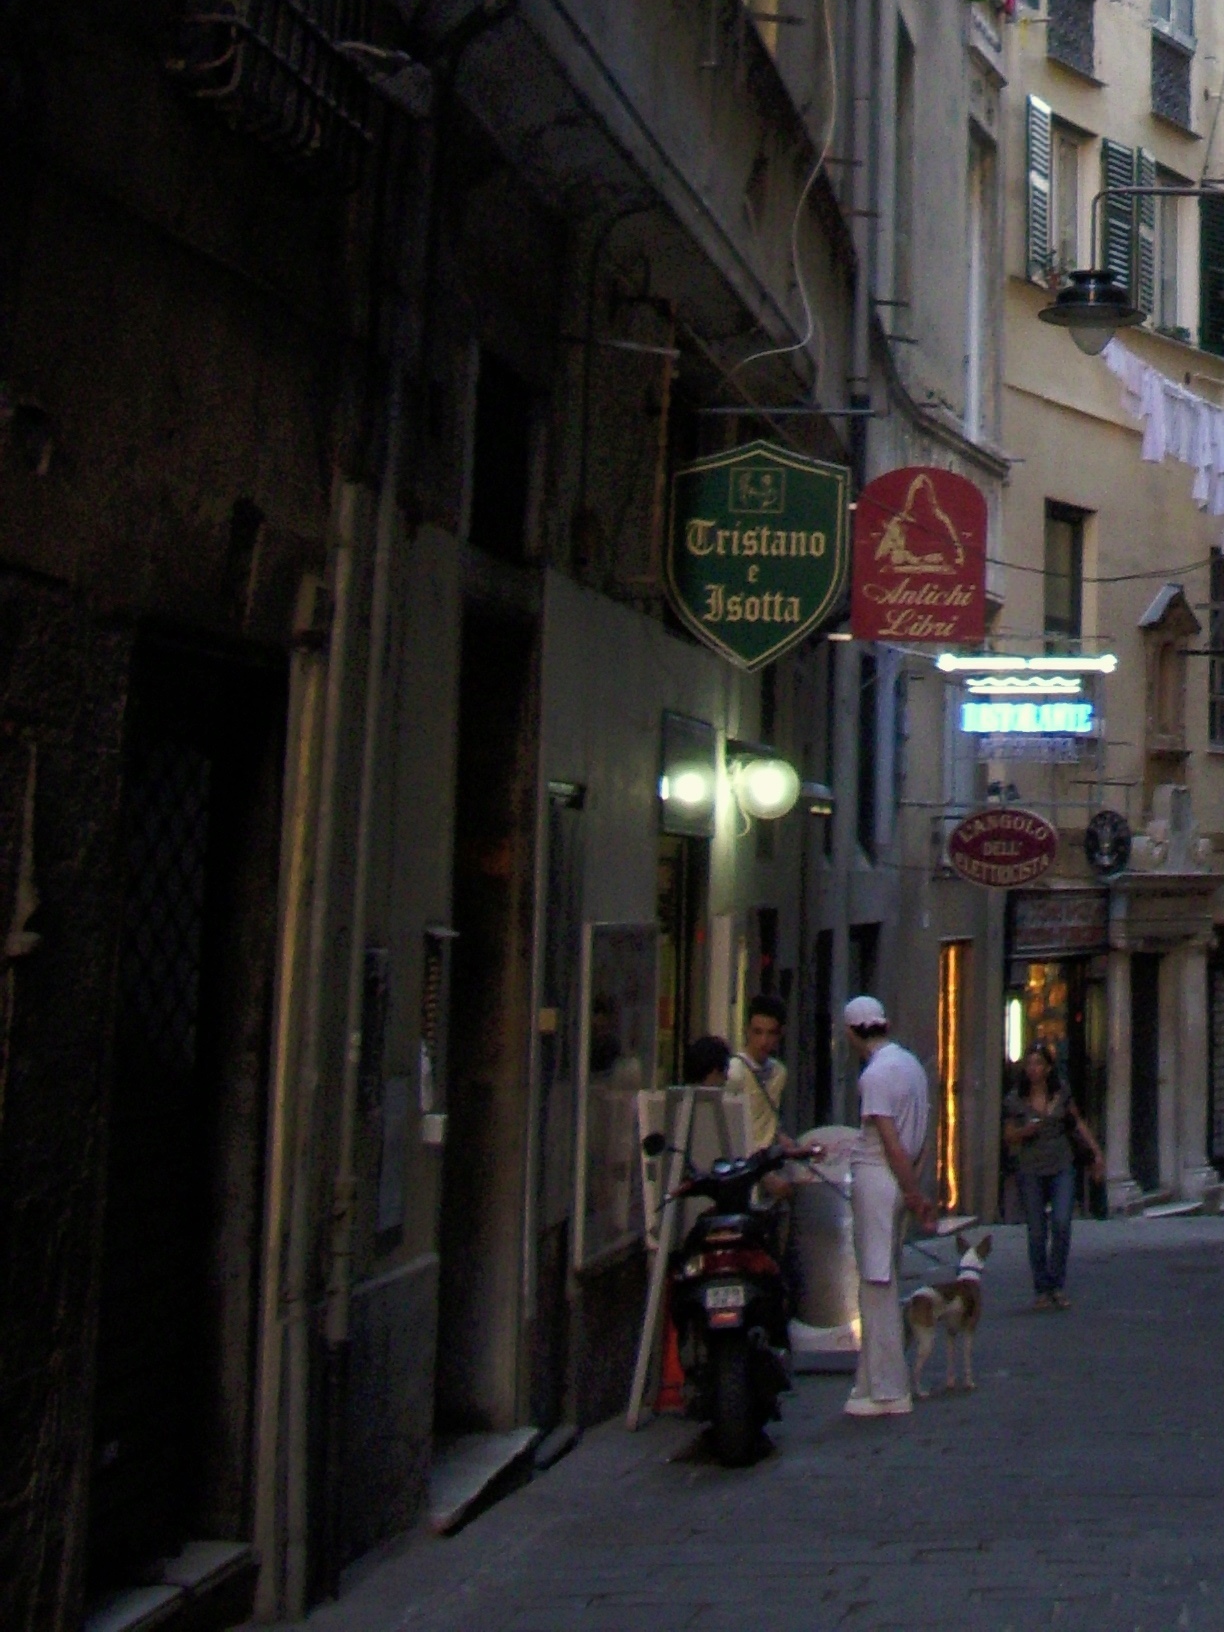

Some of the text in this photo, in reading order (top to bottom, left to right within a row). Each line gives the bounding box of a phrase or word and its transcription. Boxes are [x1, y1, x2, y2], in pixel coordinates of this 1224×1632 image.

[686, 519, 826, 557] Tristano
[747, 564, 760, 583] e
[702, 584, 801, 623] Isotta
[862, 577, 977, 607] Antichi
[877, 608, 960, 637] Libri
